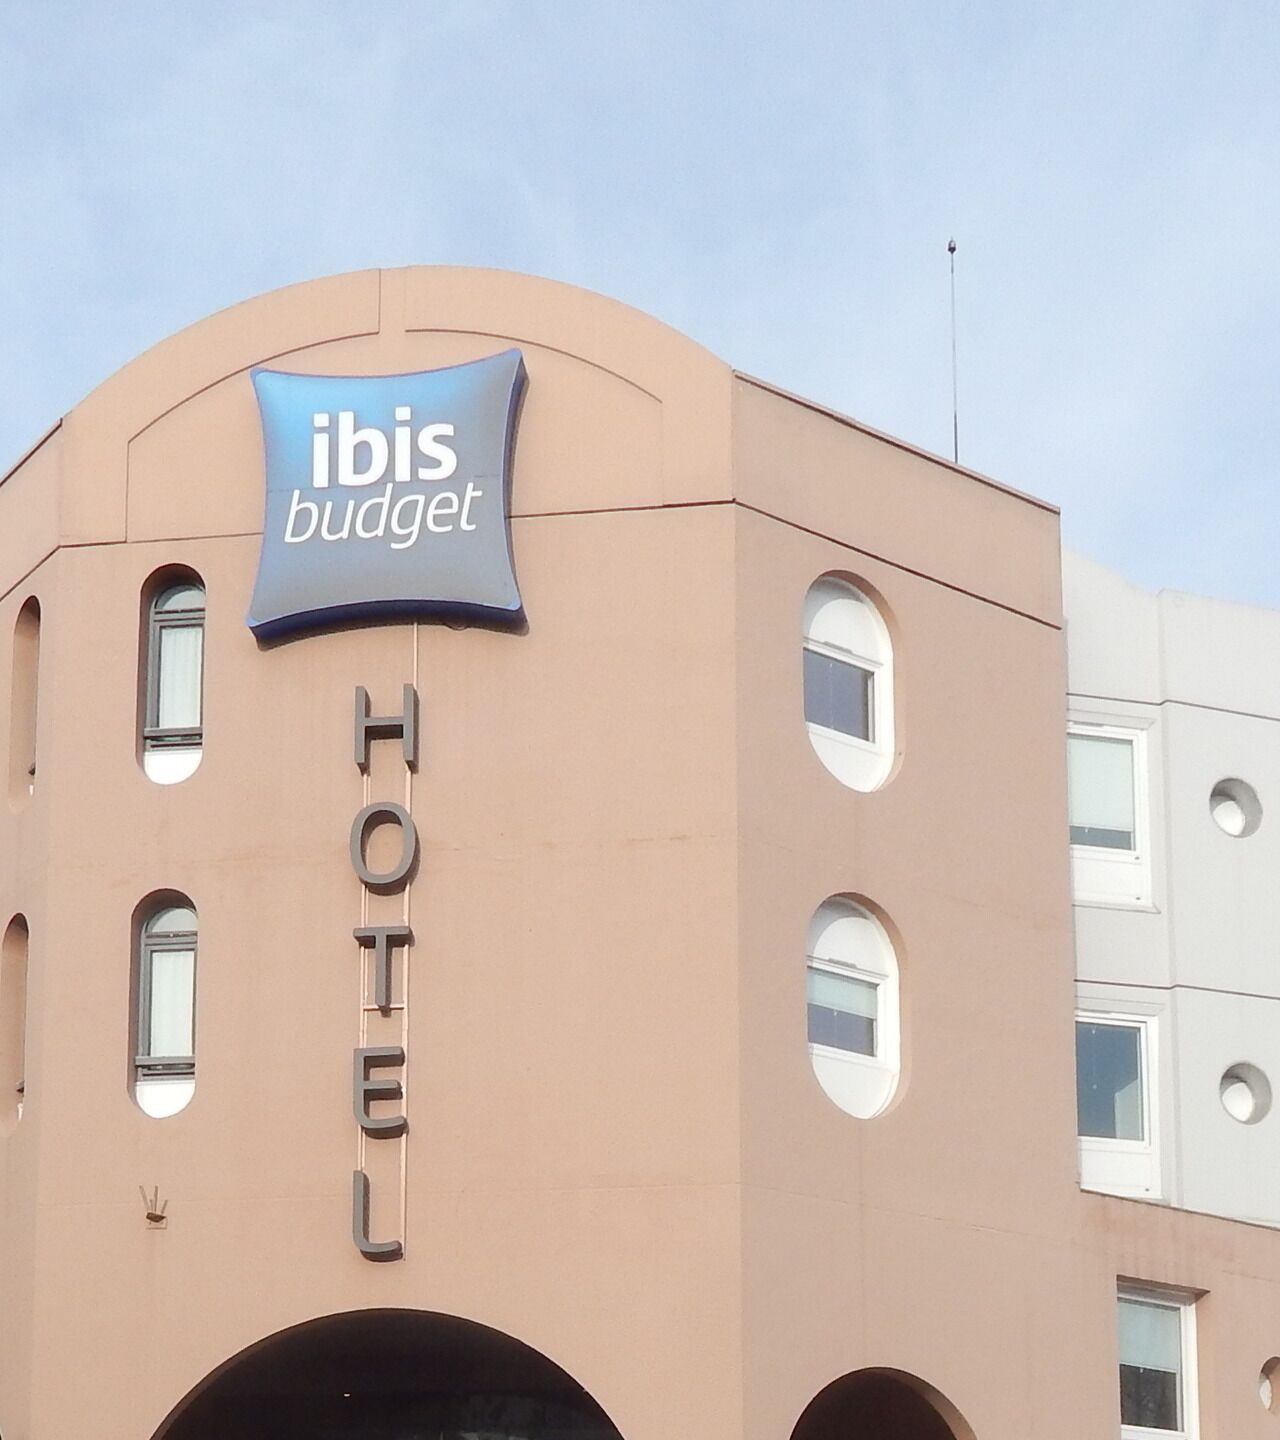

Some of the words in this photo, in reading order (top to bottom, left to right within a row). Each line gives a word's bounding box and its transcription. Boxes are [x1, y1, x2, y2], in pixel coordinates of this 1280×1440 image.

[312, 406, 458, 488] ibis
[284, 481, 483, 550] budget
[350, 683, 419, 1263] HOTEL
